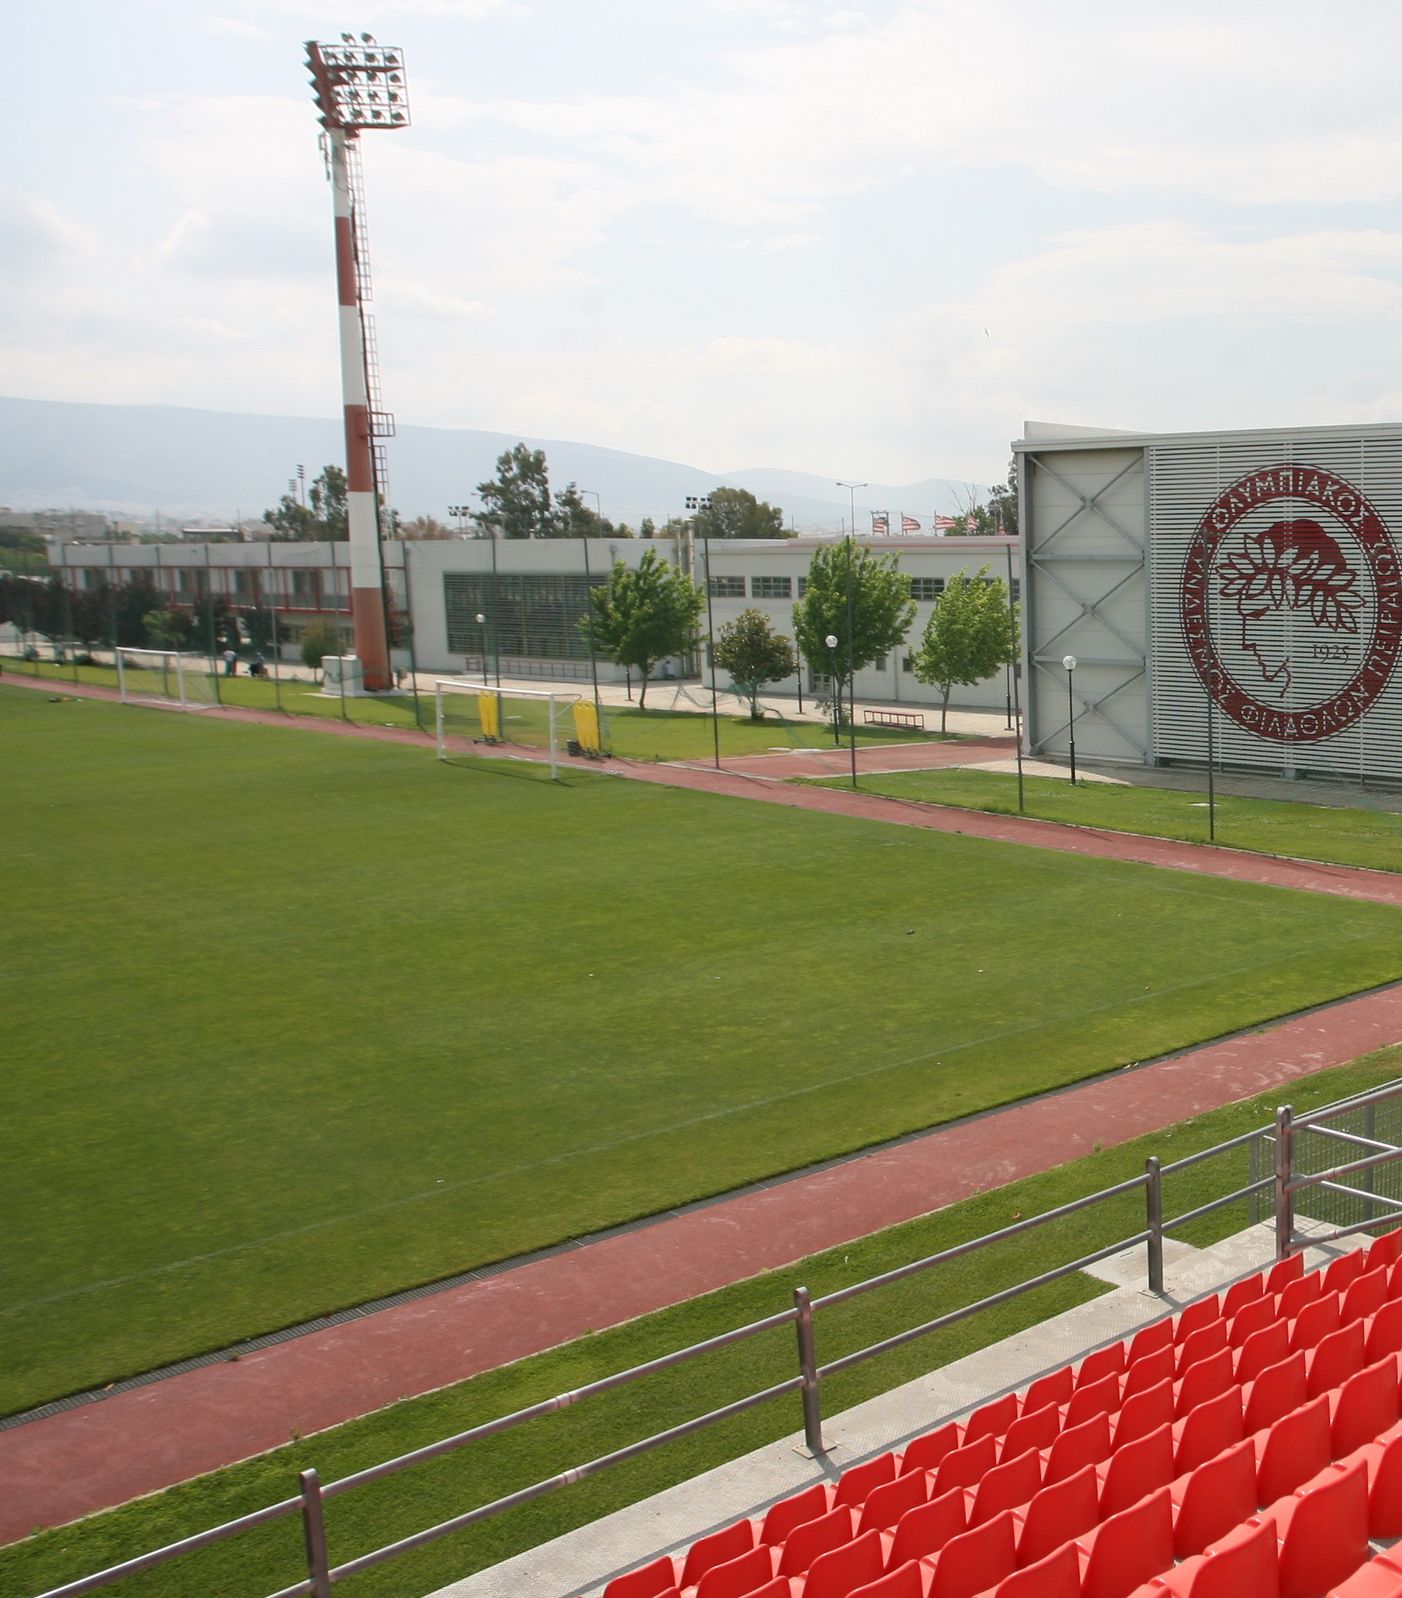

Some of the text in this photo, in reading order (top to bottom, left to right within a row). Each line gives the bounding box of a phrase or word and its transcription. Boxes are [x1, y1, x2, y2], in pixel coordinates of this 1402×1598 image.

[1212, 469, 1369, 529] ΟΛΥΜΠΙΑΚΟΣ
[1241, 680, 1370, 738] ΦΙΛΑΘΛΩΝ
[1365, 533, 1399, 677] ΠΕΙΡΑΙΩΣ
[1312, 643, 1350, 664] 1925
